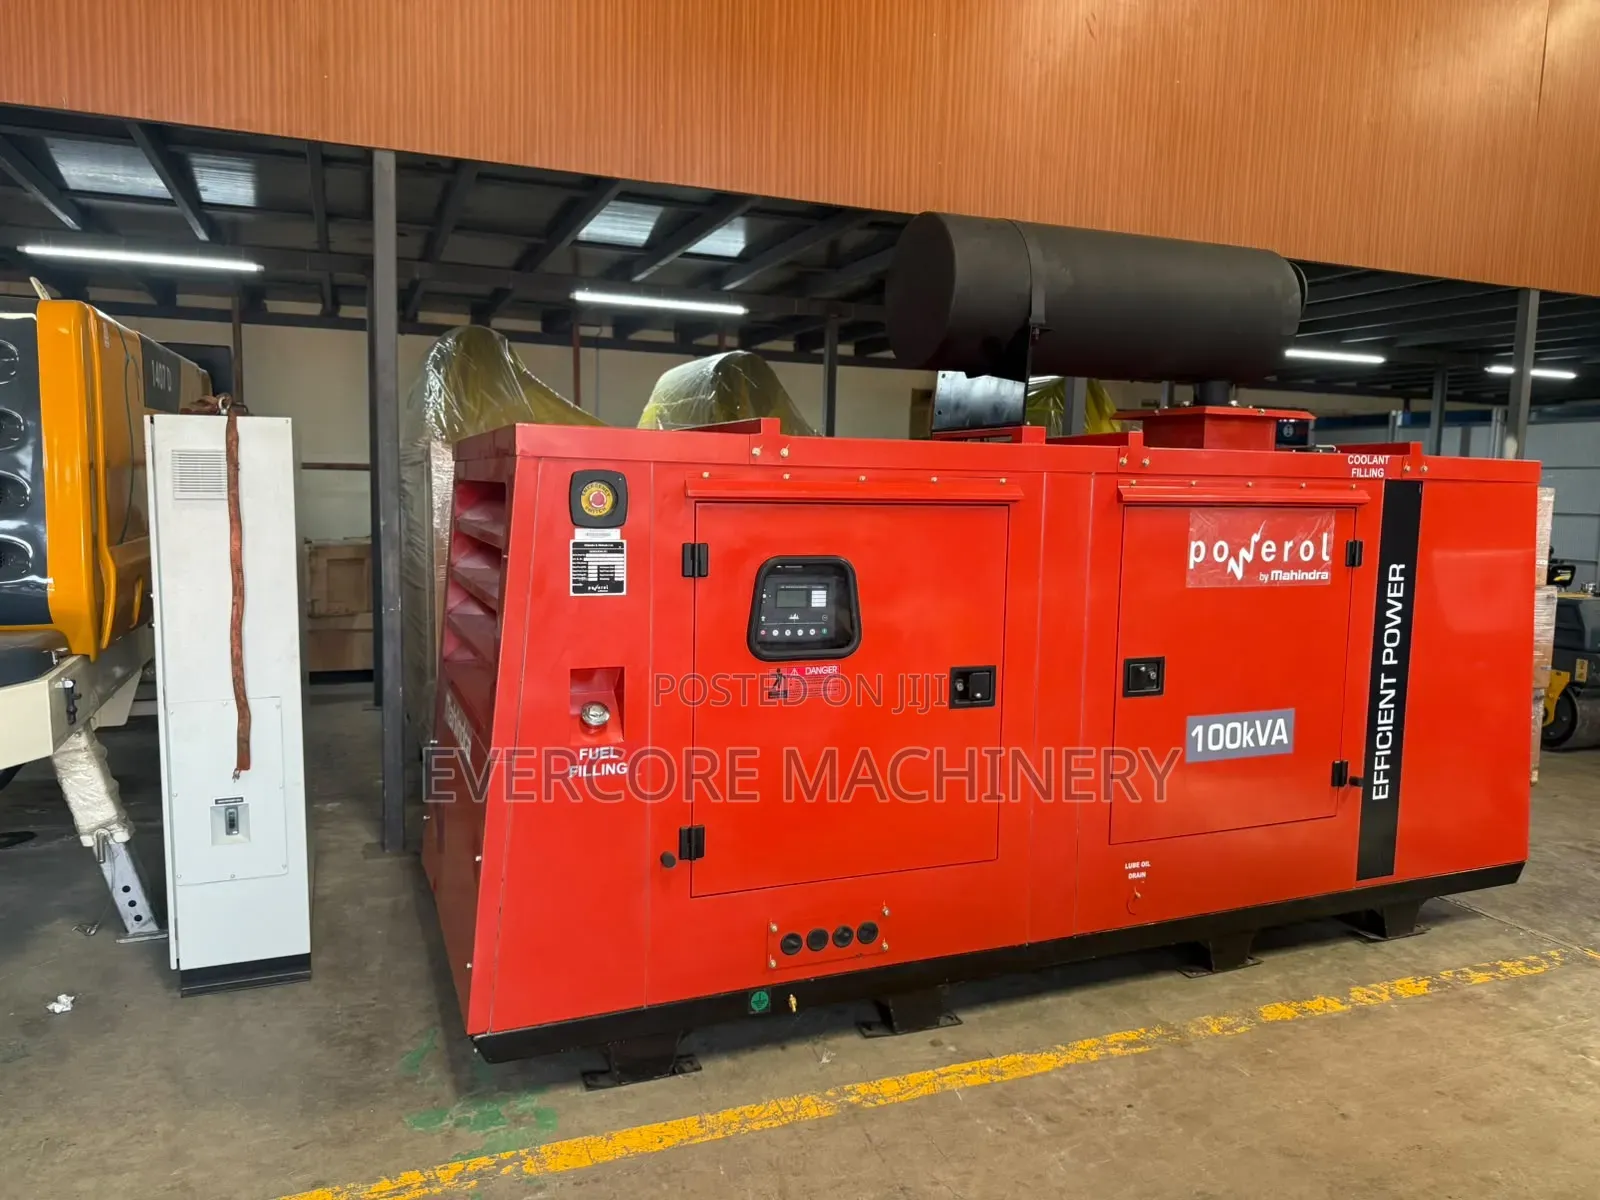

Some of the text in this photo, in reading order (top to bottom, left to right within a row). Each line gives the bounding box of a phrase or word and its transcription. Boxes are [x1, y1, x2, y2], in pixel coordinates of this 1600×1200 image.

[1347, 455, 1390, 465] COOLANT
[1351, 468, 1384, 478] FILLING
[1259, 570, 1329, 583] by Mahindra
[804, 665, 838, 676] DANGER
[1372, 563, 1406, 801] EFFICIENT POWER
[1191, 718, 1289, 752] 100kVA
[579, 746, 620, 760] FUEL
[569, 762, 629, 778] FILLING
